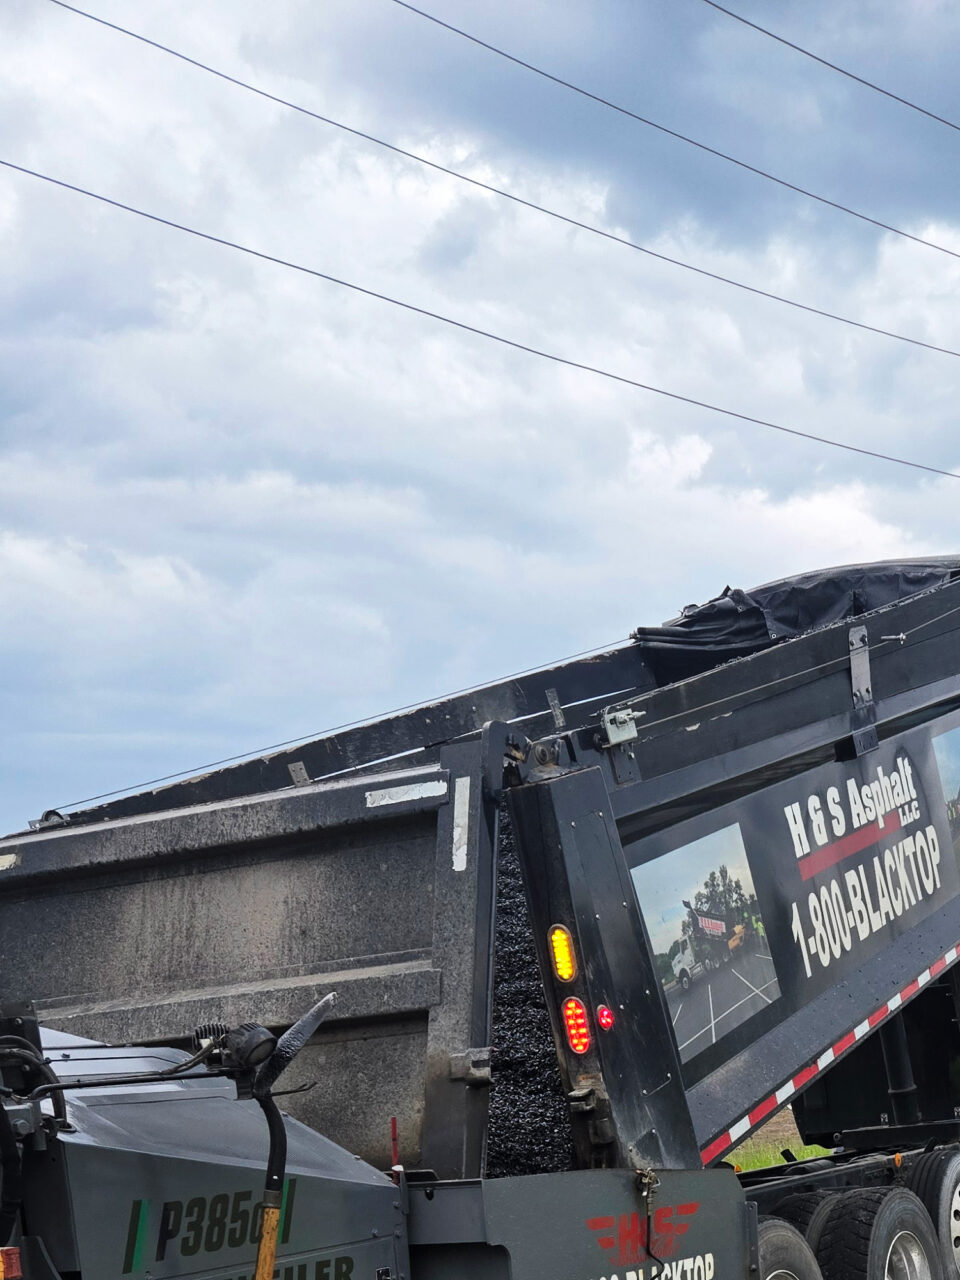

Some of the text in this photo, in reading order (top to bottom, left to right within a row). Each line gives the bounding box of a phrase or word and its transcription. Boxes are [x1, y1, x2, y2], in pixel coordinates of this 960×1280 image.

[784, 757, 917, 859] H & S Asphalt
[898, 801, 920, 827] LLC
[791, 825, 941, 978] 1-800-BLACKTOP
